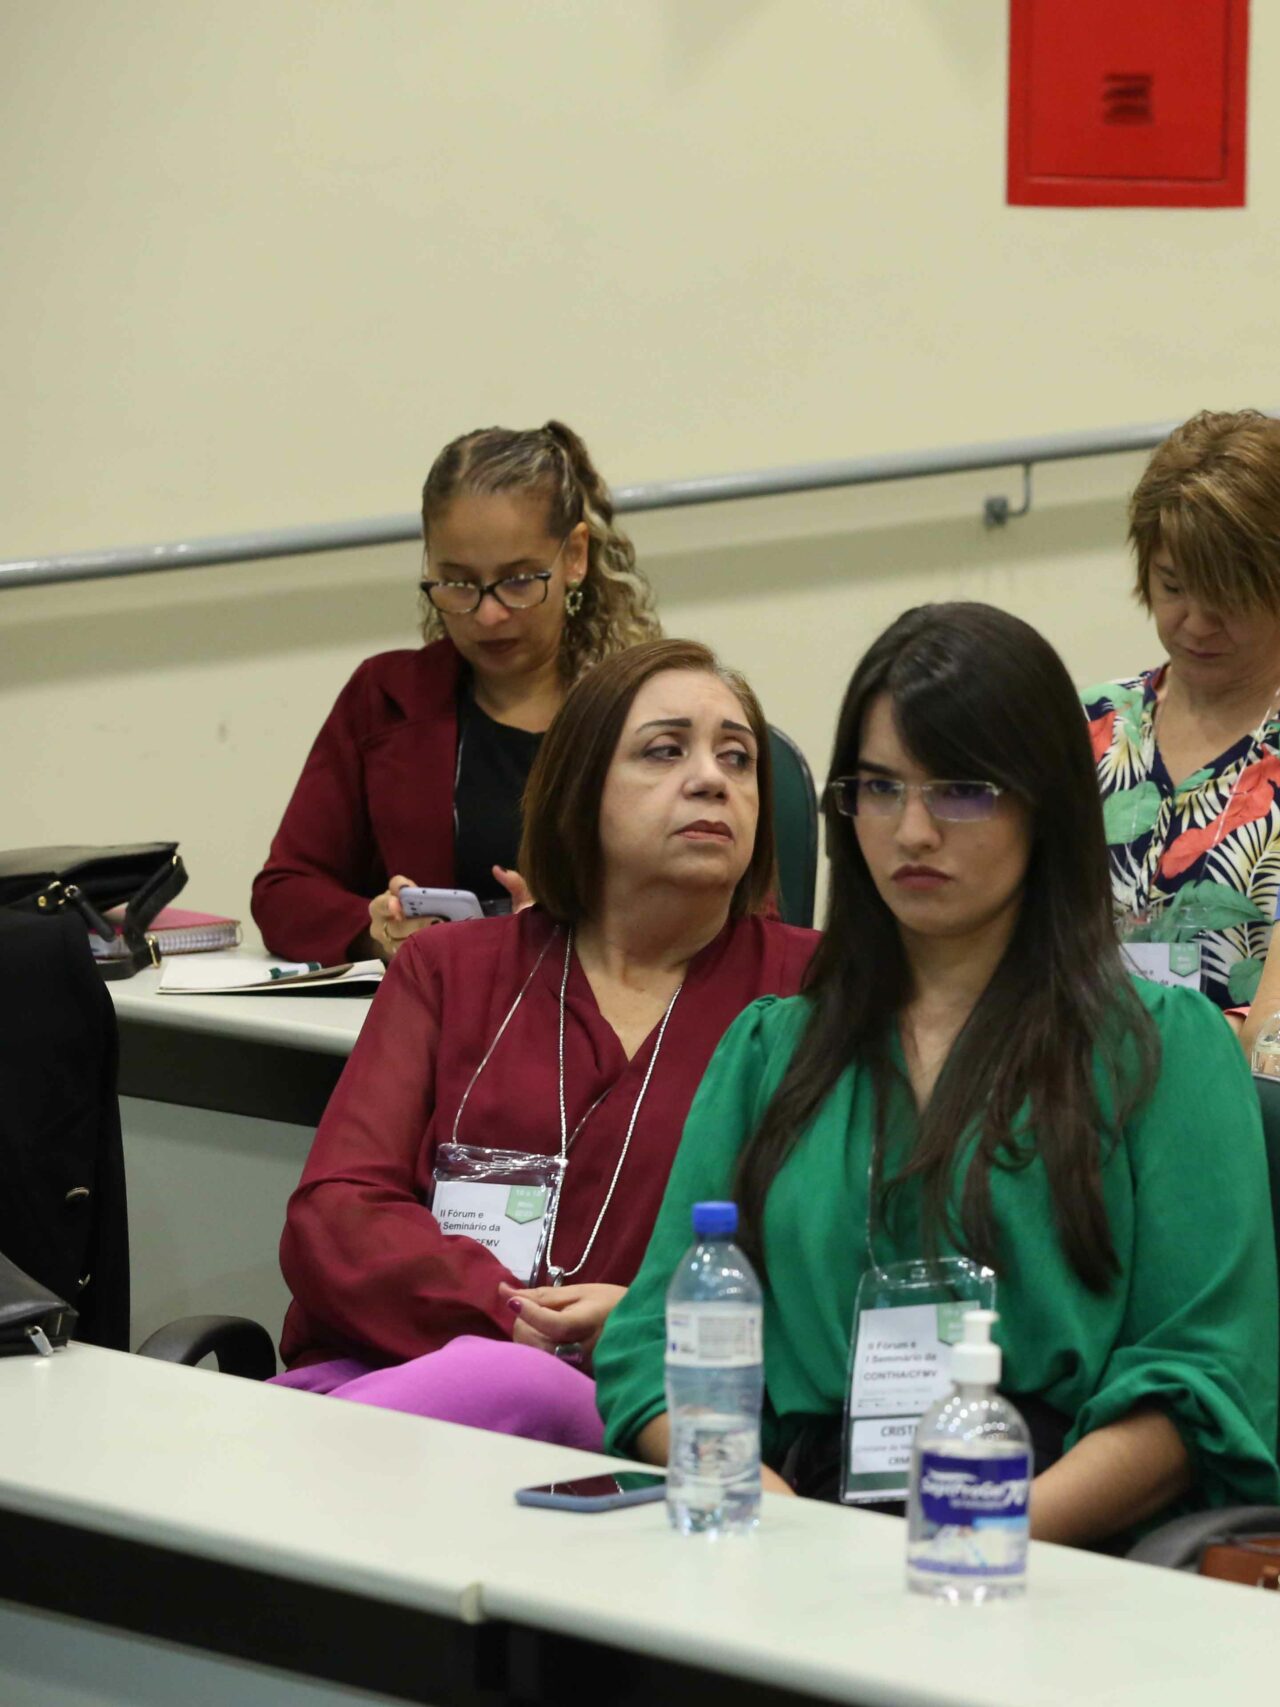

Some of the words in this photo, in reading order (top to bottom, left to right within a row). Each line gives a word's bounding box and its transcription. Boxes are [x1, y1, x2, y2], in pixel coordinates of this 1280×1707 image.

[447, 1209, 476, 1218] Fórum
[443, 1222, 487, 1231] Seminário
[489, 1224, 501, 1232] da
